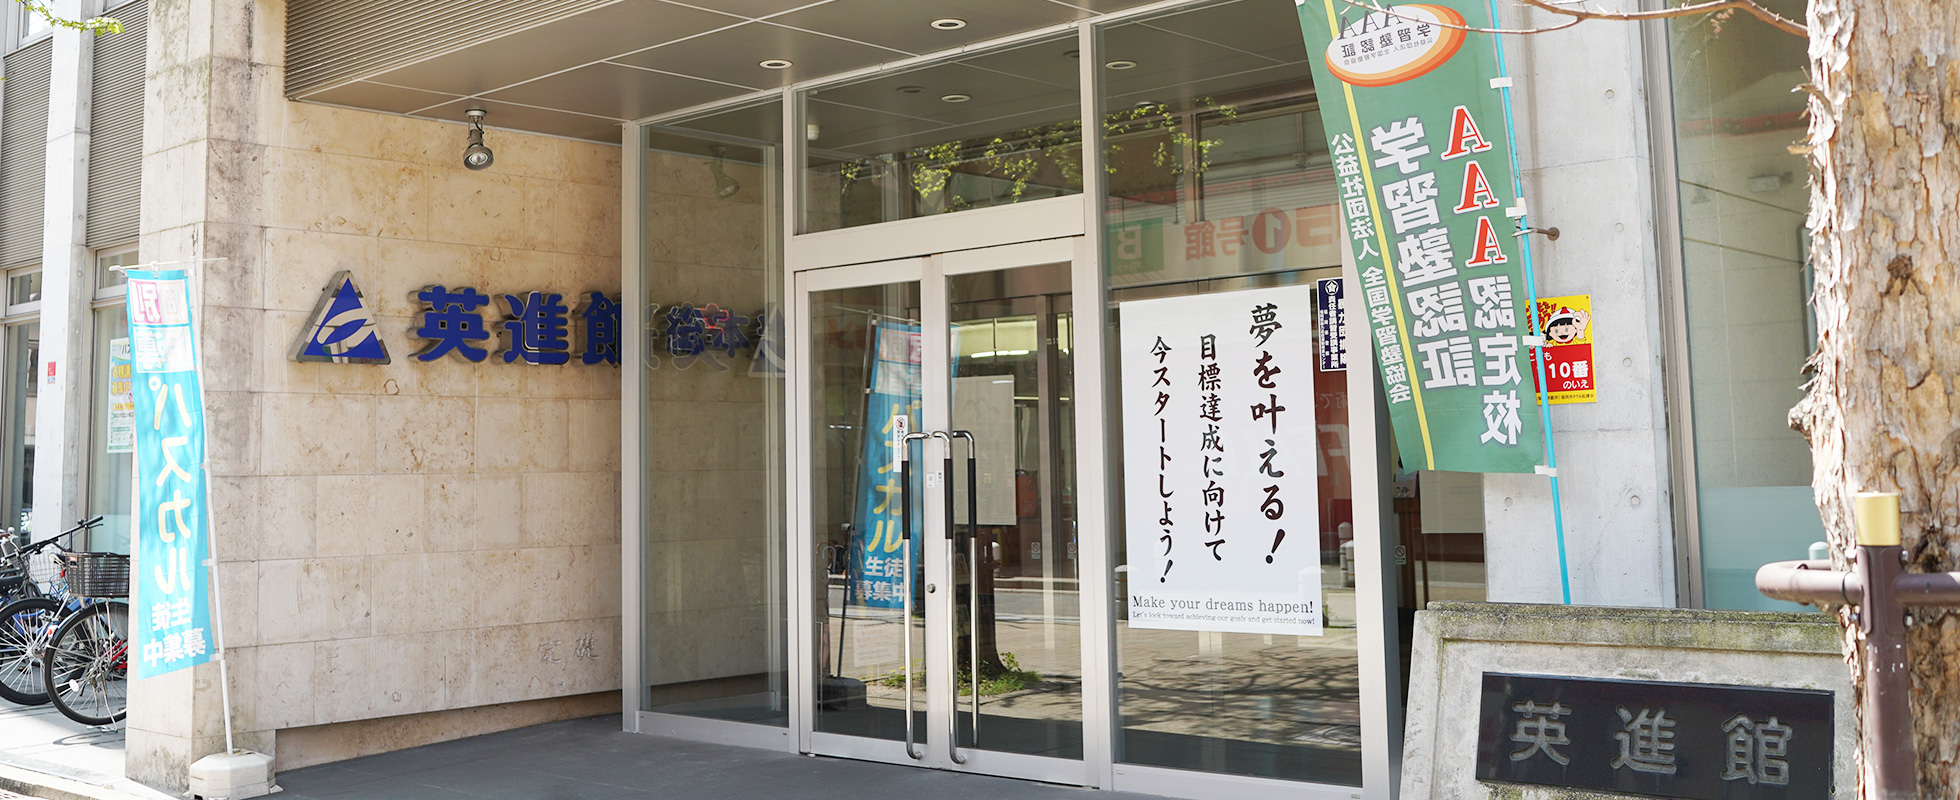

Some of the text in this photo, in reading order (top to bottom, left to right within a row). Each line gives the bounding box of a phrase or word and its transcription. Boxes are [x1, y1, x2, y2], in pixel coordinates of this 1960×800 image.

[1548, 360, 1589, 378] 10番
[1562, 379, 1589, 389] のいえ
[1197, 333, 1227, 562] 目標達成に向けて
[1132, 595, 1314, 615] Make your dreams happen!
[1149, 611, 1162, 619] look
[1163, 612, 1185, 620] toward
[1186, 613, 1216, 623] achieving
[1230, 615, 1247, 623] goals
[1261, 616, 1273, 624] get
[1298, 618, 1315, 626] now!
[537, 630, 602, 664] 定礎
[1508, 696, 1794, 786] 英進館
